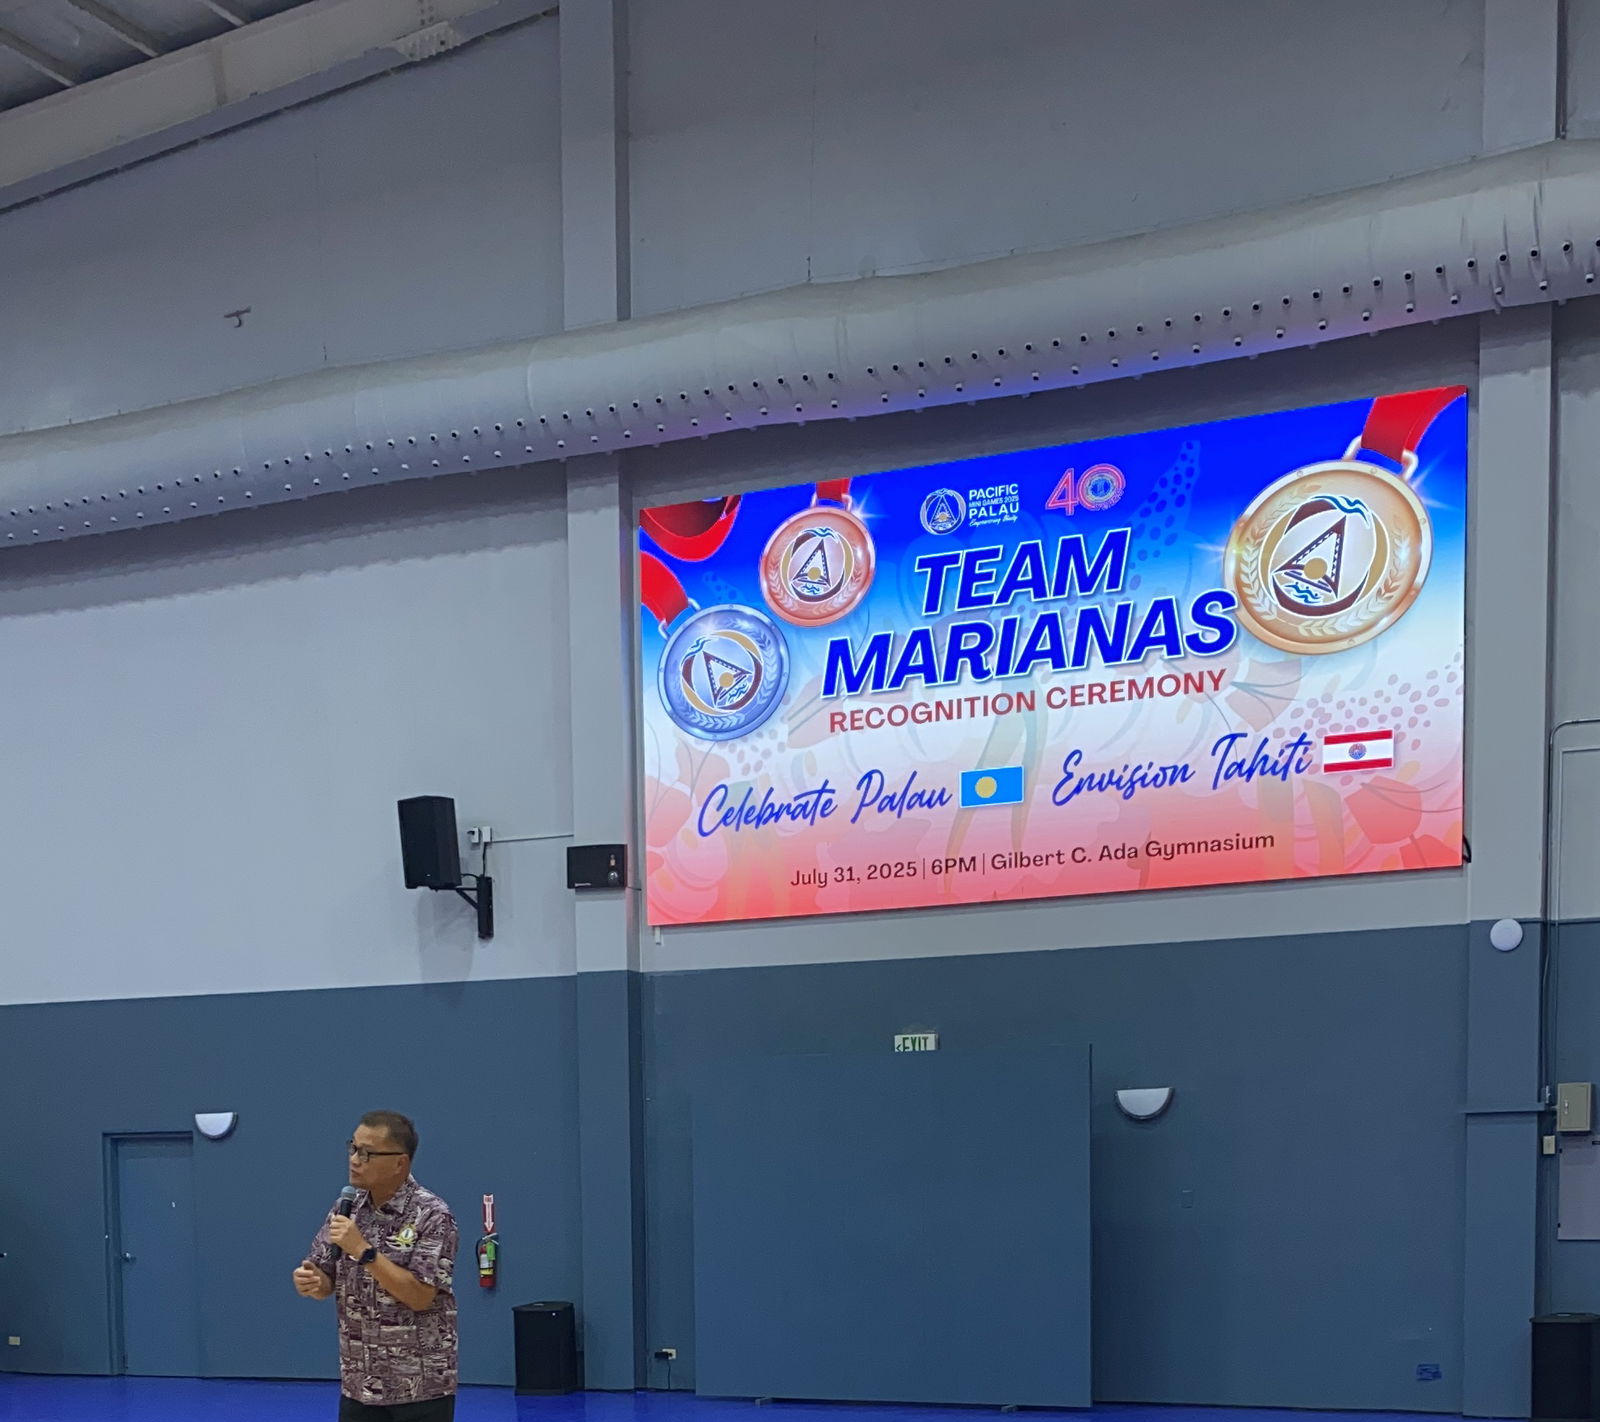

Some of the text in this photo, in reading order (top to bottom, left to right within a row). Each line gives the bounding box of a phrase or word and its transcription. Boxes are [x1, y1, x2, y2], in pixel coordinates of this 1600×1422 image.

[969, 483, 1019, 501] PACIFIC
[969, 502, 1019, 519] PALAU
[914, 527, 1132, 616] TEAM
[821, 588, 1238, 699] MARIANAS
[829, 668, 1228, 733] RECOGNITION CEREMONY
[1052, 731, 1313, 806] Envision Tahiti
[698, 769, 953, 837] Celebrate Palau
[790, 832, 1275, 889] July 31, 2025 6PM Gilbert C. Ada Gymnasium
[902, 1036, 929, 1052] EXIT
